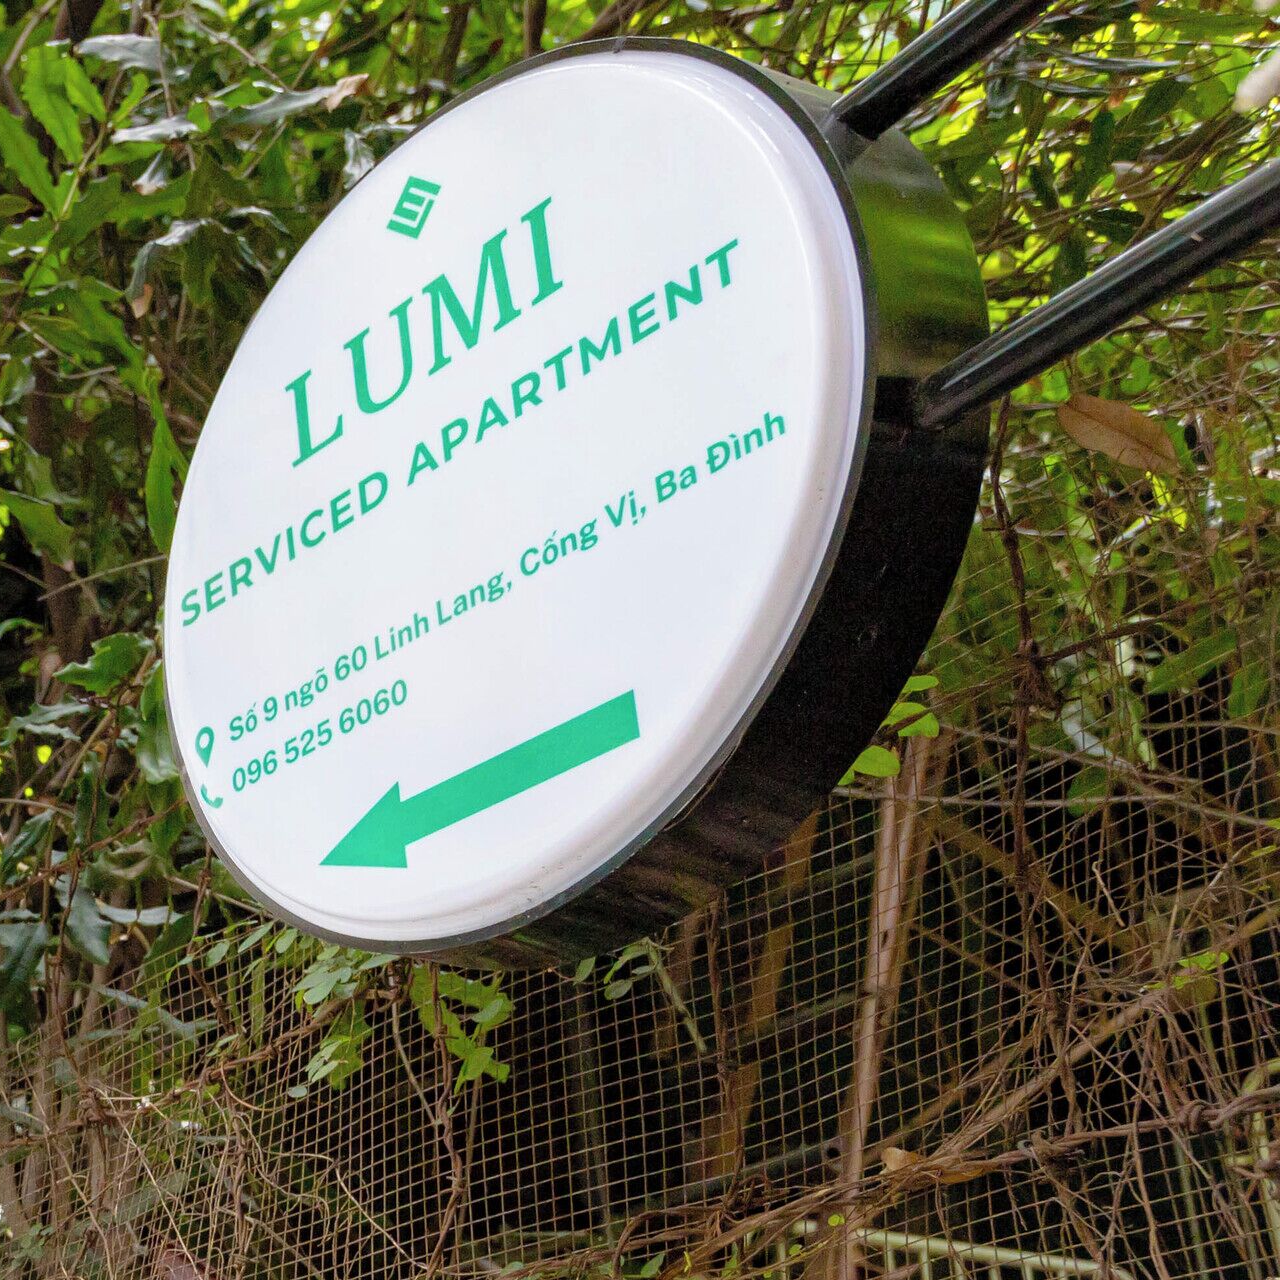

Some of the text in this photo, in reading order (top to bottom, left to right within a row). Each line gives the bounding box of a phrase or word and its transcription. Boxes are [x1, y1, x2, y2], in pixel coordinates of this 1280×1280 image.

[181, 239, 739, 627] SERVICED APARTMENT
[284, 195, 564, 468] LUMI
[229, 411, 786, 742] Số 9 ngõ 60 Linh Lang, Cống Vị, Ba Đình
[231, 678, 409, 794] 096 525 6060
